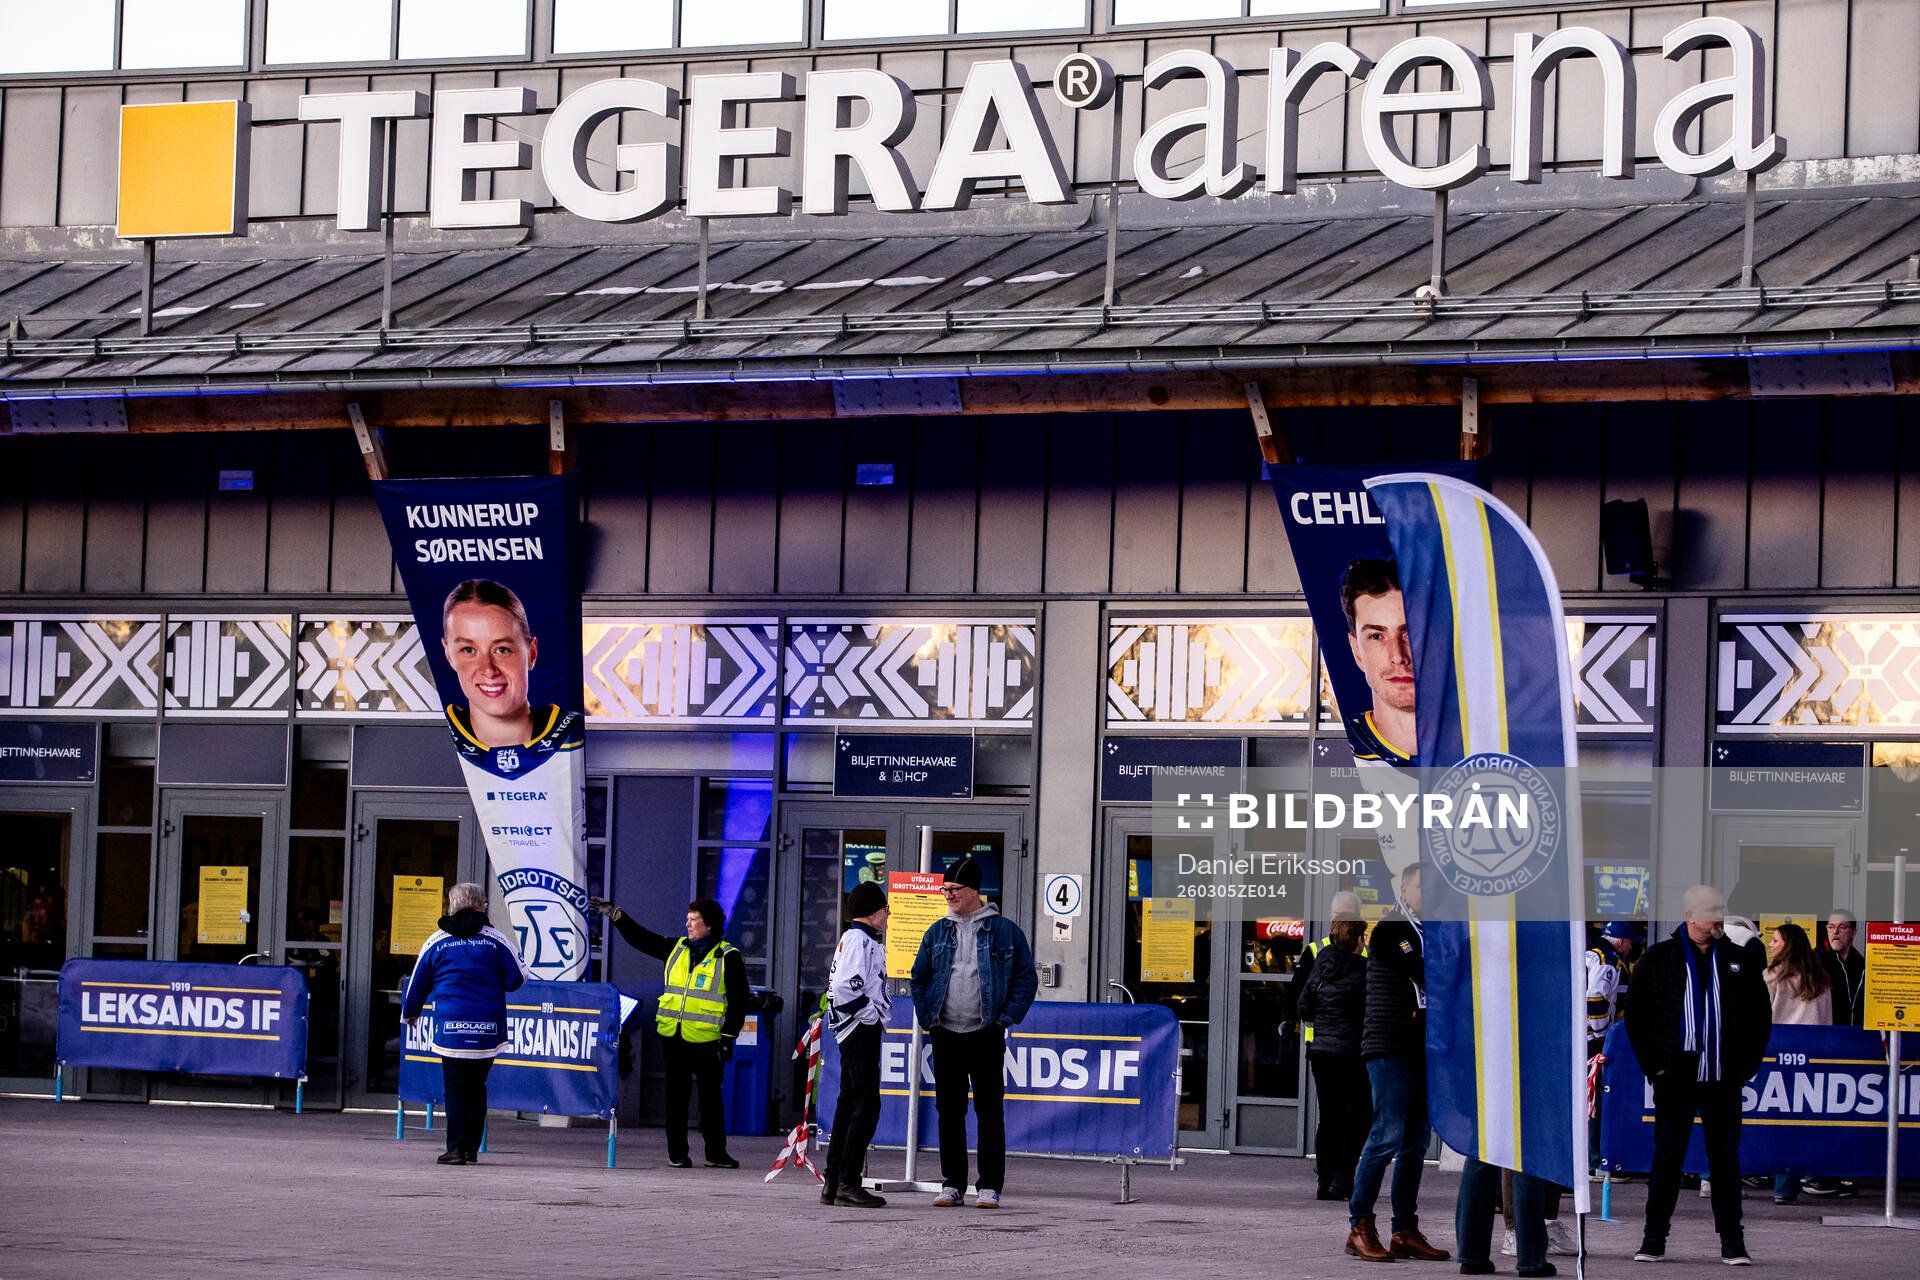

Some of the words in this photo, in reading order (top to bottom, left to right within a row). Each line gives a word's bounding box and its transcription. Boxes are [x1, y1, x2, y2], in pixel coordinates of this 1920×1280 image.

[1132, 16, 1787, 202] arena
[405, 502, 540, 529] KUNNERUP
[1290, 491, 1387, 525] CEHL
[414, 537, 544, 564] SØRENSEN
[496, 756, 520, 769] 50
[851, 755, 957, 768] BILJETTINNEHAVARE
[878, 771, 887, 782] &
[904, 772, 929, 782] HCP
[1119, 765, 1226, 778] BILJETTINNEHAVARE
[1729, 770, 1846, 784] BILJETTINNEHAVARE
[508, 839, 540, 847] TRAVEL
[1055, 883, 1069, 907] 4
[171, 981, 191, 992] 1919
[81, 991, 245, 1030] LEKSANDS
[251, 1000, 281, 1031] IF
[505, 1017, 580, 1056] EKSANDS
[581, 1021, 599, 1060] IF
[881, 1042, 1088, 1091] EKNDS
[1098, 1049, 1140, 1091] IF
[1778, 1053, 1807, 1066] 1919
